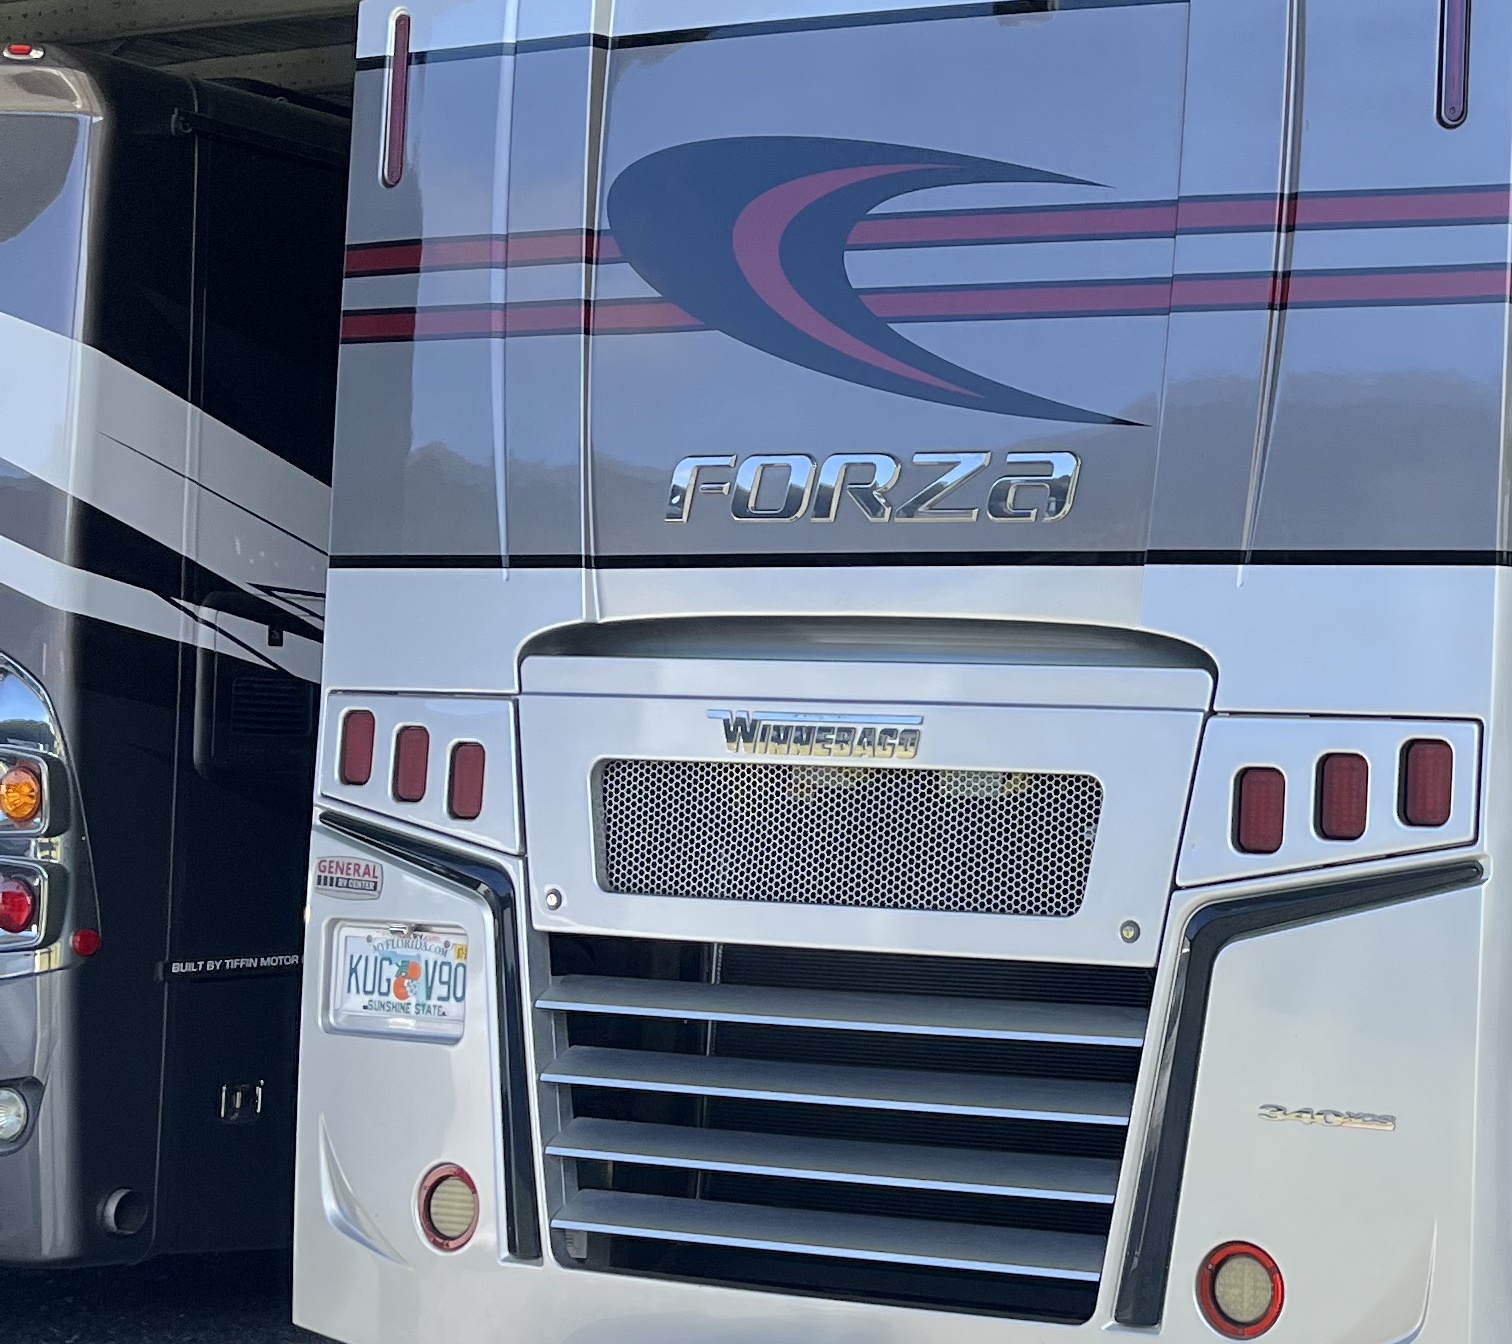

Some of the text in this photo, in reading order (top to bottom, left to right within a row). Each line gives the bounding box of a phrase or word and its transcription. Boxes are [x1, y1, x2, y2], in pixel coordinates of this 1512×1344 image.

[709, 709, 924, 759] WINNEBAGO
[318, 859, 379, 880] GENERAL
[171, 962, 204, 973] BUILT
[206, 960, 222, 971] BY
[224, 957, 258, 970] TIFFIN
[260, 955, 299, 967] MOTOR
[347, 954, 467, 1002] KUG V90
[367, 999, 443, 1016] SUNSHINE STATE
